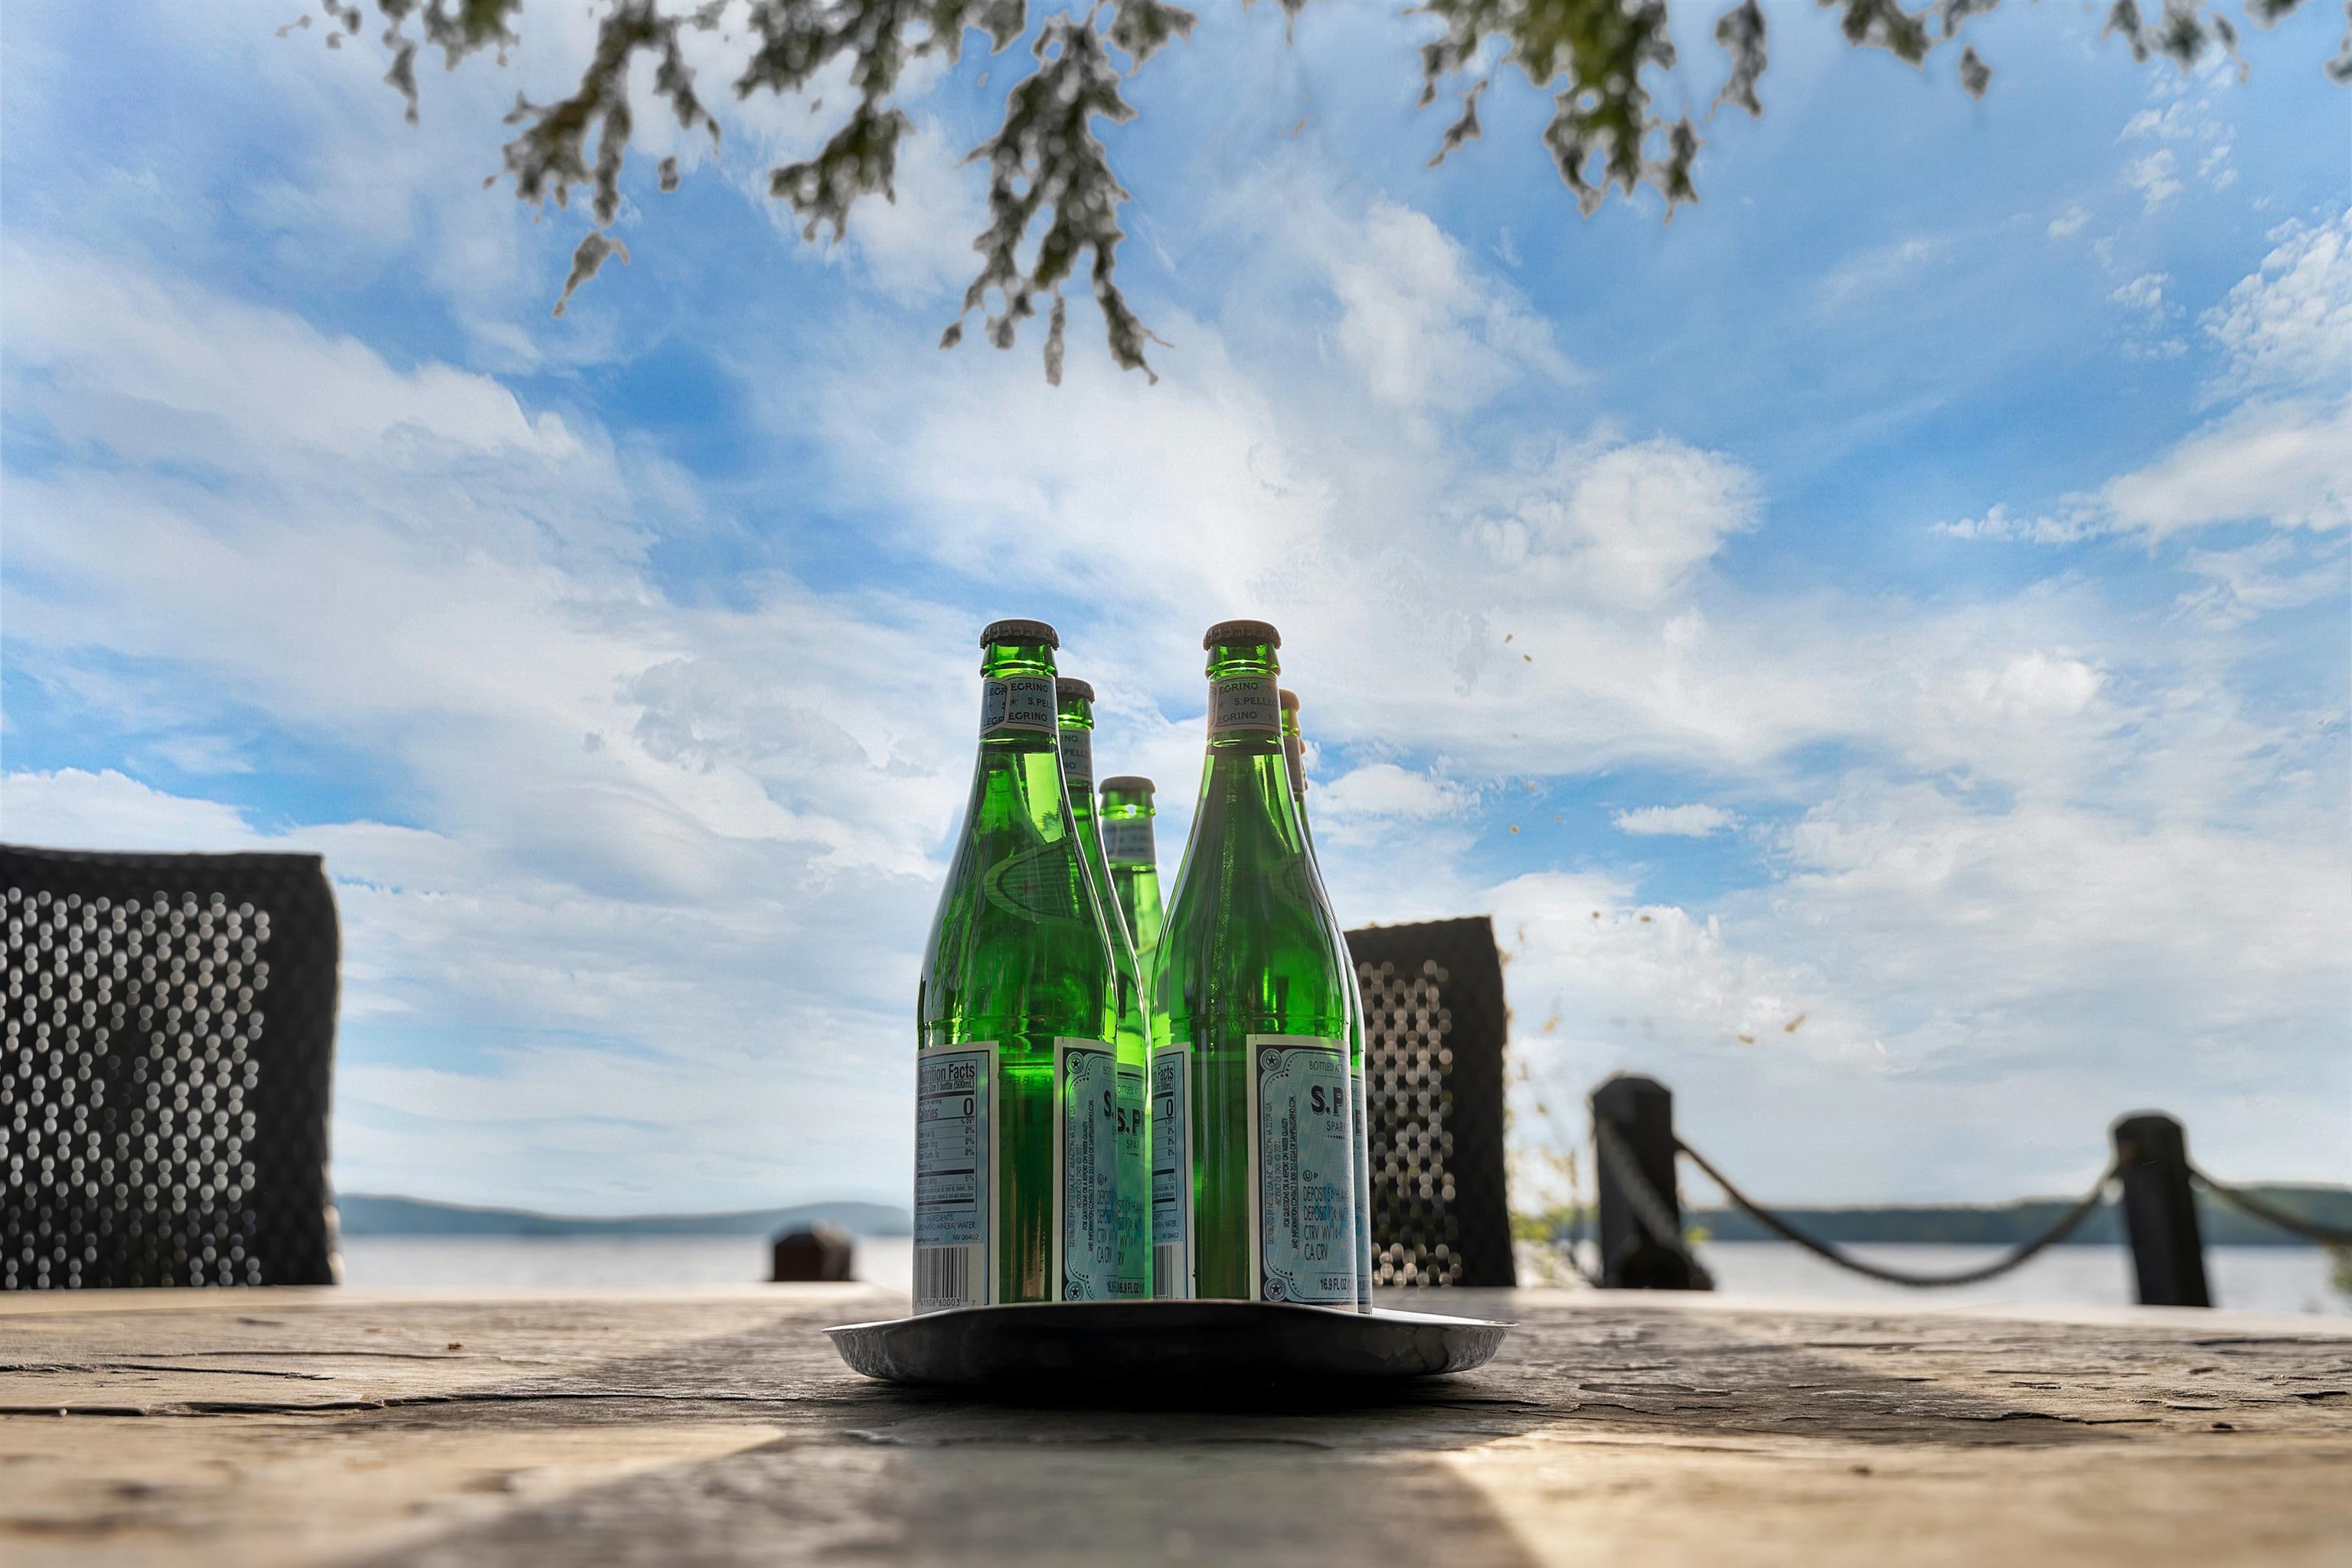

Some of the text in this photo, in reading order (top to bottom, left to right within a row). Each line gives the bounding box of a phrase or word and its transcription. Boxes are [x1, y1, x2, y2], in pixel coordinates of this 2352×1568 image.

[1011, 683, 1048, 692] EGRINO
[1219, 682, 1259, 694] EGRINO
[1009, 712, 1047, 721] EGRINO
[1218, 711, 1258, 724] EGRINO
[949, 1063, 975, 1080] Facts
[1309, 1060, 1334, 1072] BOTTLED
[1158, 1065, 1174, 1081] Facts
[954, 1080, 975, 1091] (500mL)
[963, 1097, 974, 1116] 0
[1166, 1099, 1174, 1117] 0
[1303, 1187, 1325, 1202] DEPOSIT
[1303, 1206, 1327, 1222] DEPOSIT
[957, 1221, 975, 1230] WATER
[1304, 1243, 1328, 1261] CA CRV
[1320, 1278, 1332, 1291] 16.9
[1333, 1278, 1340, 1291] FL
[1341, 1278, 1347, 1291] OZ
[938, 1298, 961, 1307] 80003
